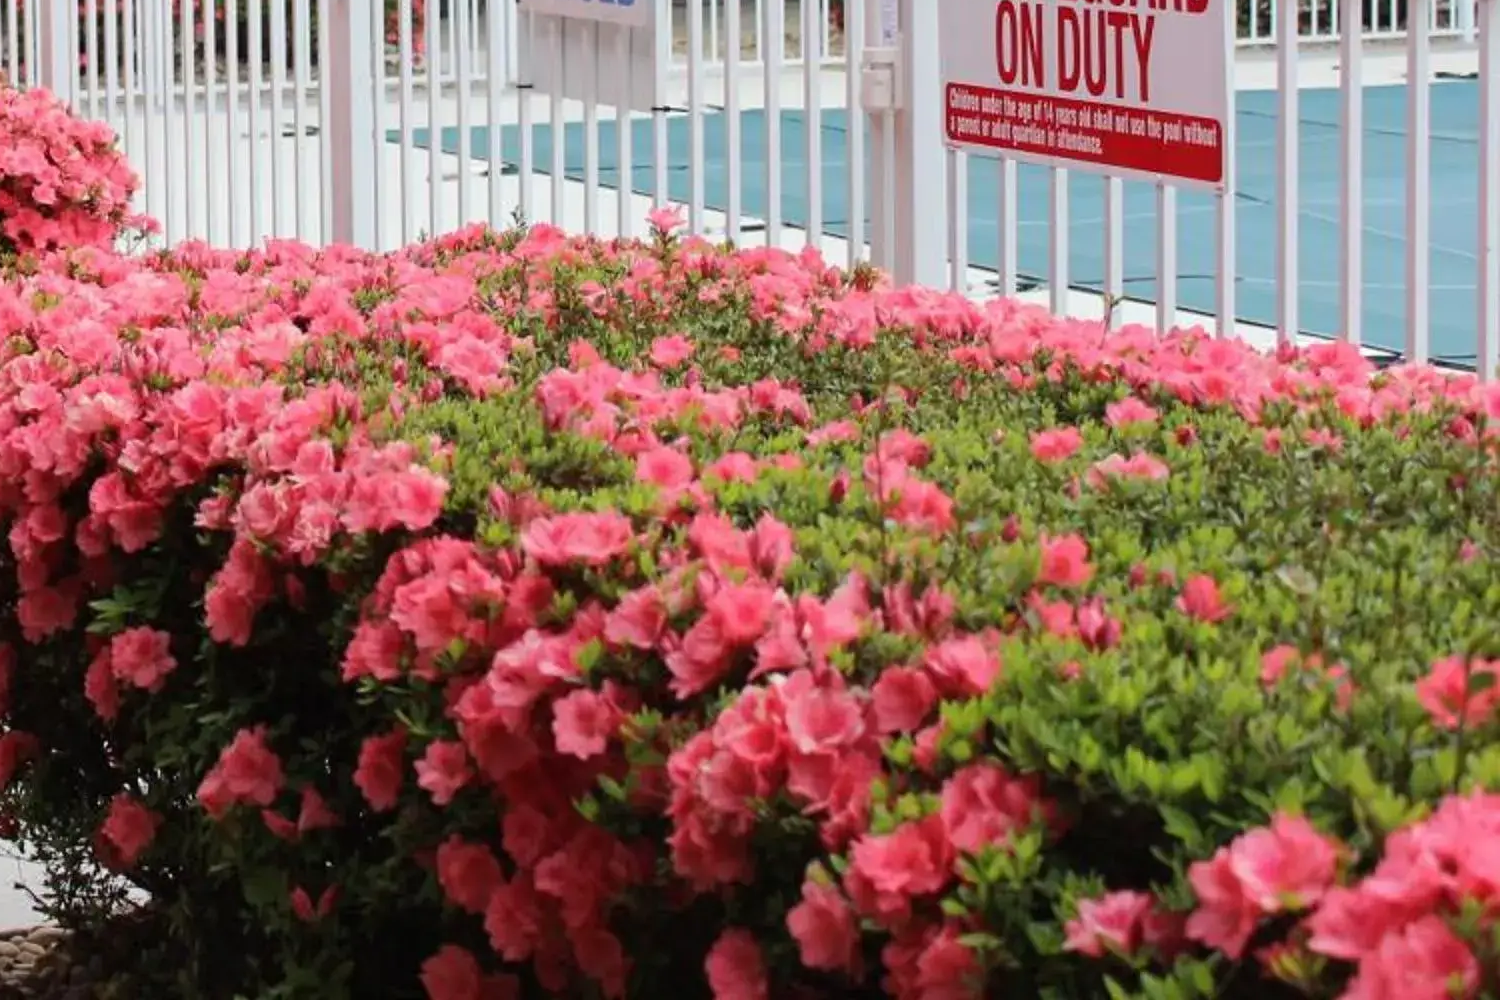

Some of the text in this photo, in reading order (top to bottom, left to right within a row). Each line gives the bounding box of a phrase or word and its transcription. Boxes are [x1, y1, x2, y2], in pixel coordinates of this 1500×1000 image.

[996, 0, 1045, 88] ON
[1058, 5, 1155, 103] DUTY
[949, 87, 1217, 148] Children under the age of 14 years old shall not use the pool without
[958, 116, 981, 137] parent
[982, 120, 990, 137] or
[991, 118, 1011, 140] adult
[1012, 122, 1046, 147] guardian
[1047, 126, 1055, 147] in
